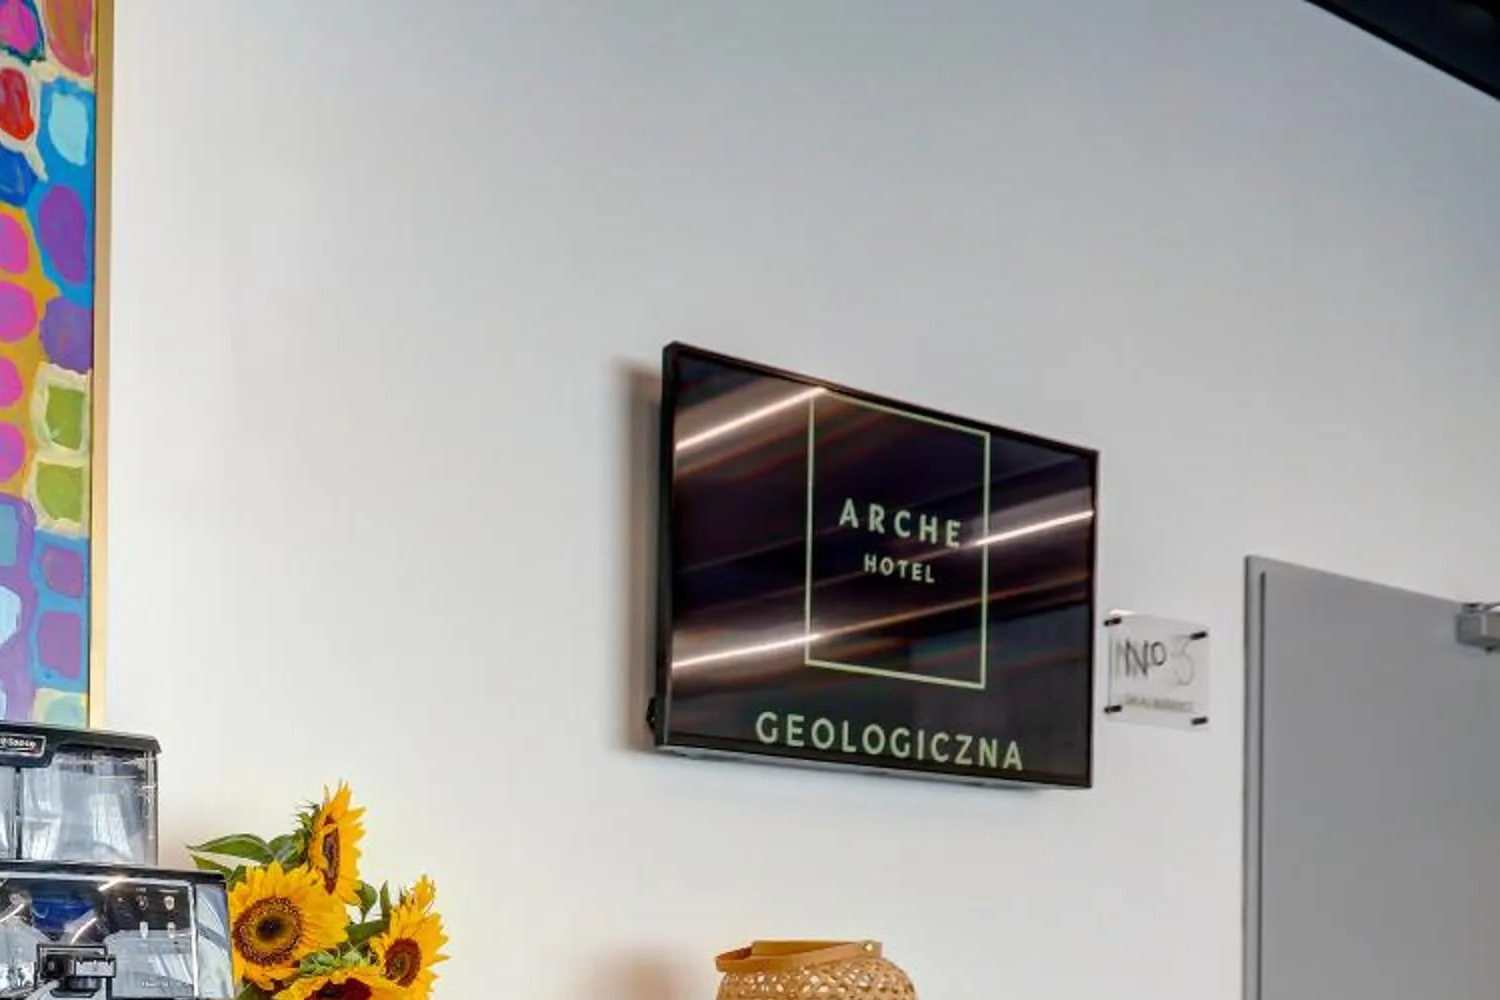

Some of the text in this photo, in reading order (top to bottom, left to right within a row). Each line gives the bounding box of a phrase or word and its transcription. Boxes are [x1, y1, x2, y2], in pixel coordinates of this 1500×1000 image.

[839, 497, 963, 548] ARCHE
[863, 553, 935, 584] HOTEL
[755, 710, 1024, 771] GEOLOGICZNA
